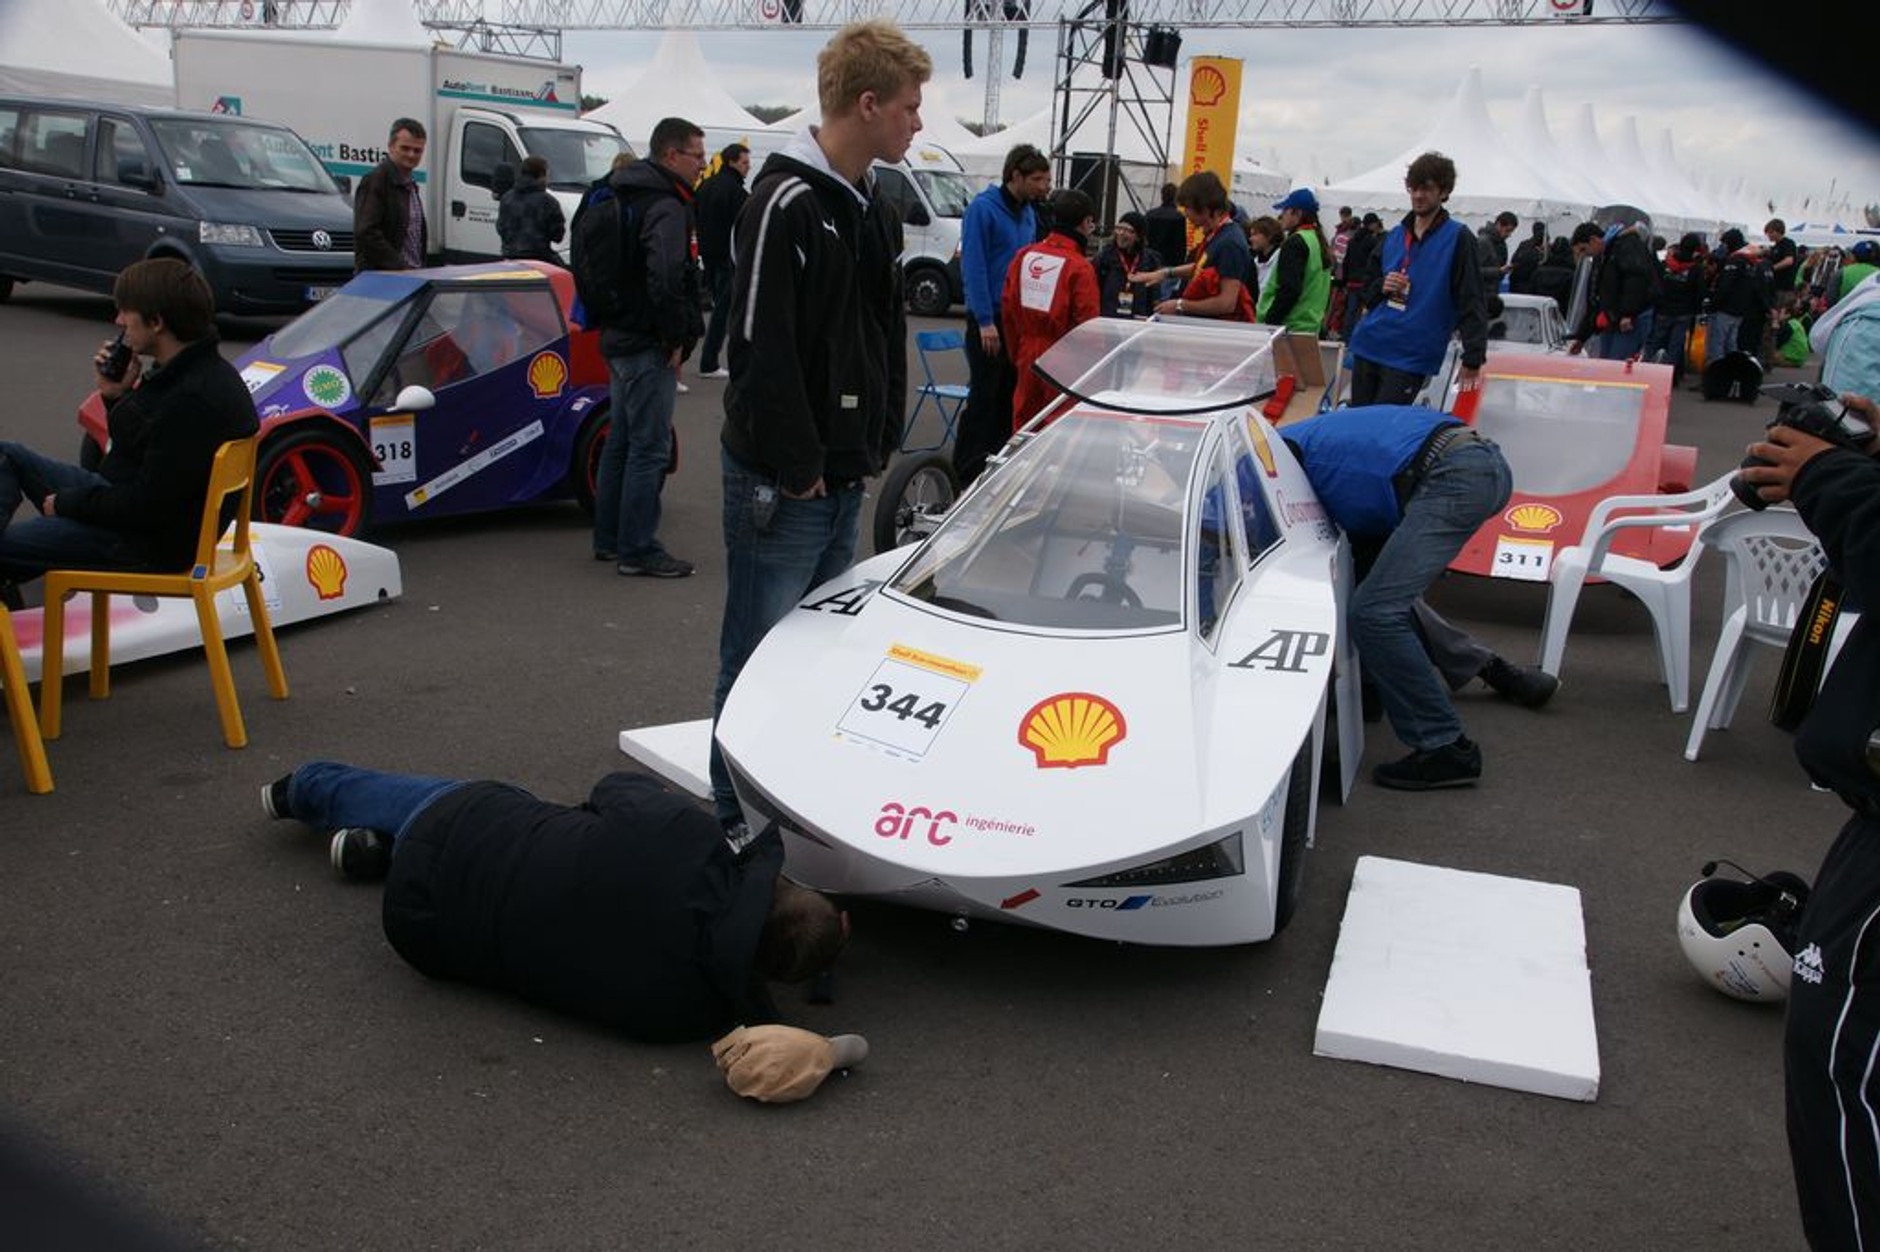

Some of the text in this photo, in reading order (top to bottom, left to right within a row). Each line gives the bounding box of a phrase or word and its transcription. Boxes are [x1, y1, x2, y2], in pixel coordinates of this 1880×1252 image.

[1195, 117, 1209, 152] Shell
[374, 441, 412, 462] 318
[1498, 551, 1544, 567] 311
[1810, 598, 1835, 644] Nikon
[1226, 629, 1331, 674] AP
[860, 683, 947, 730] 344
[874, 802, 1036, 847] arc ingénierie
[1066, 898, 1118, 909] GTO
